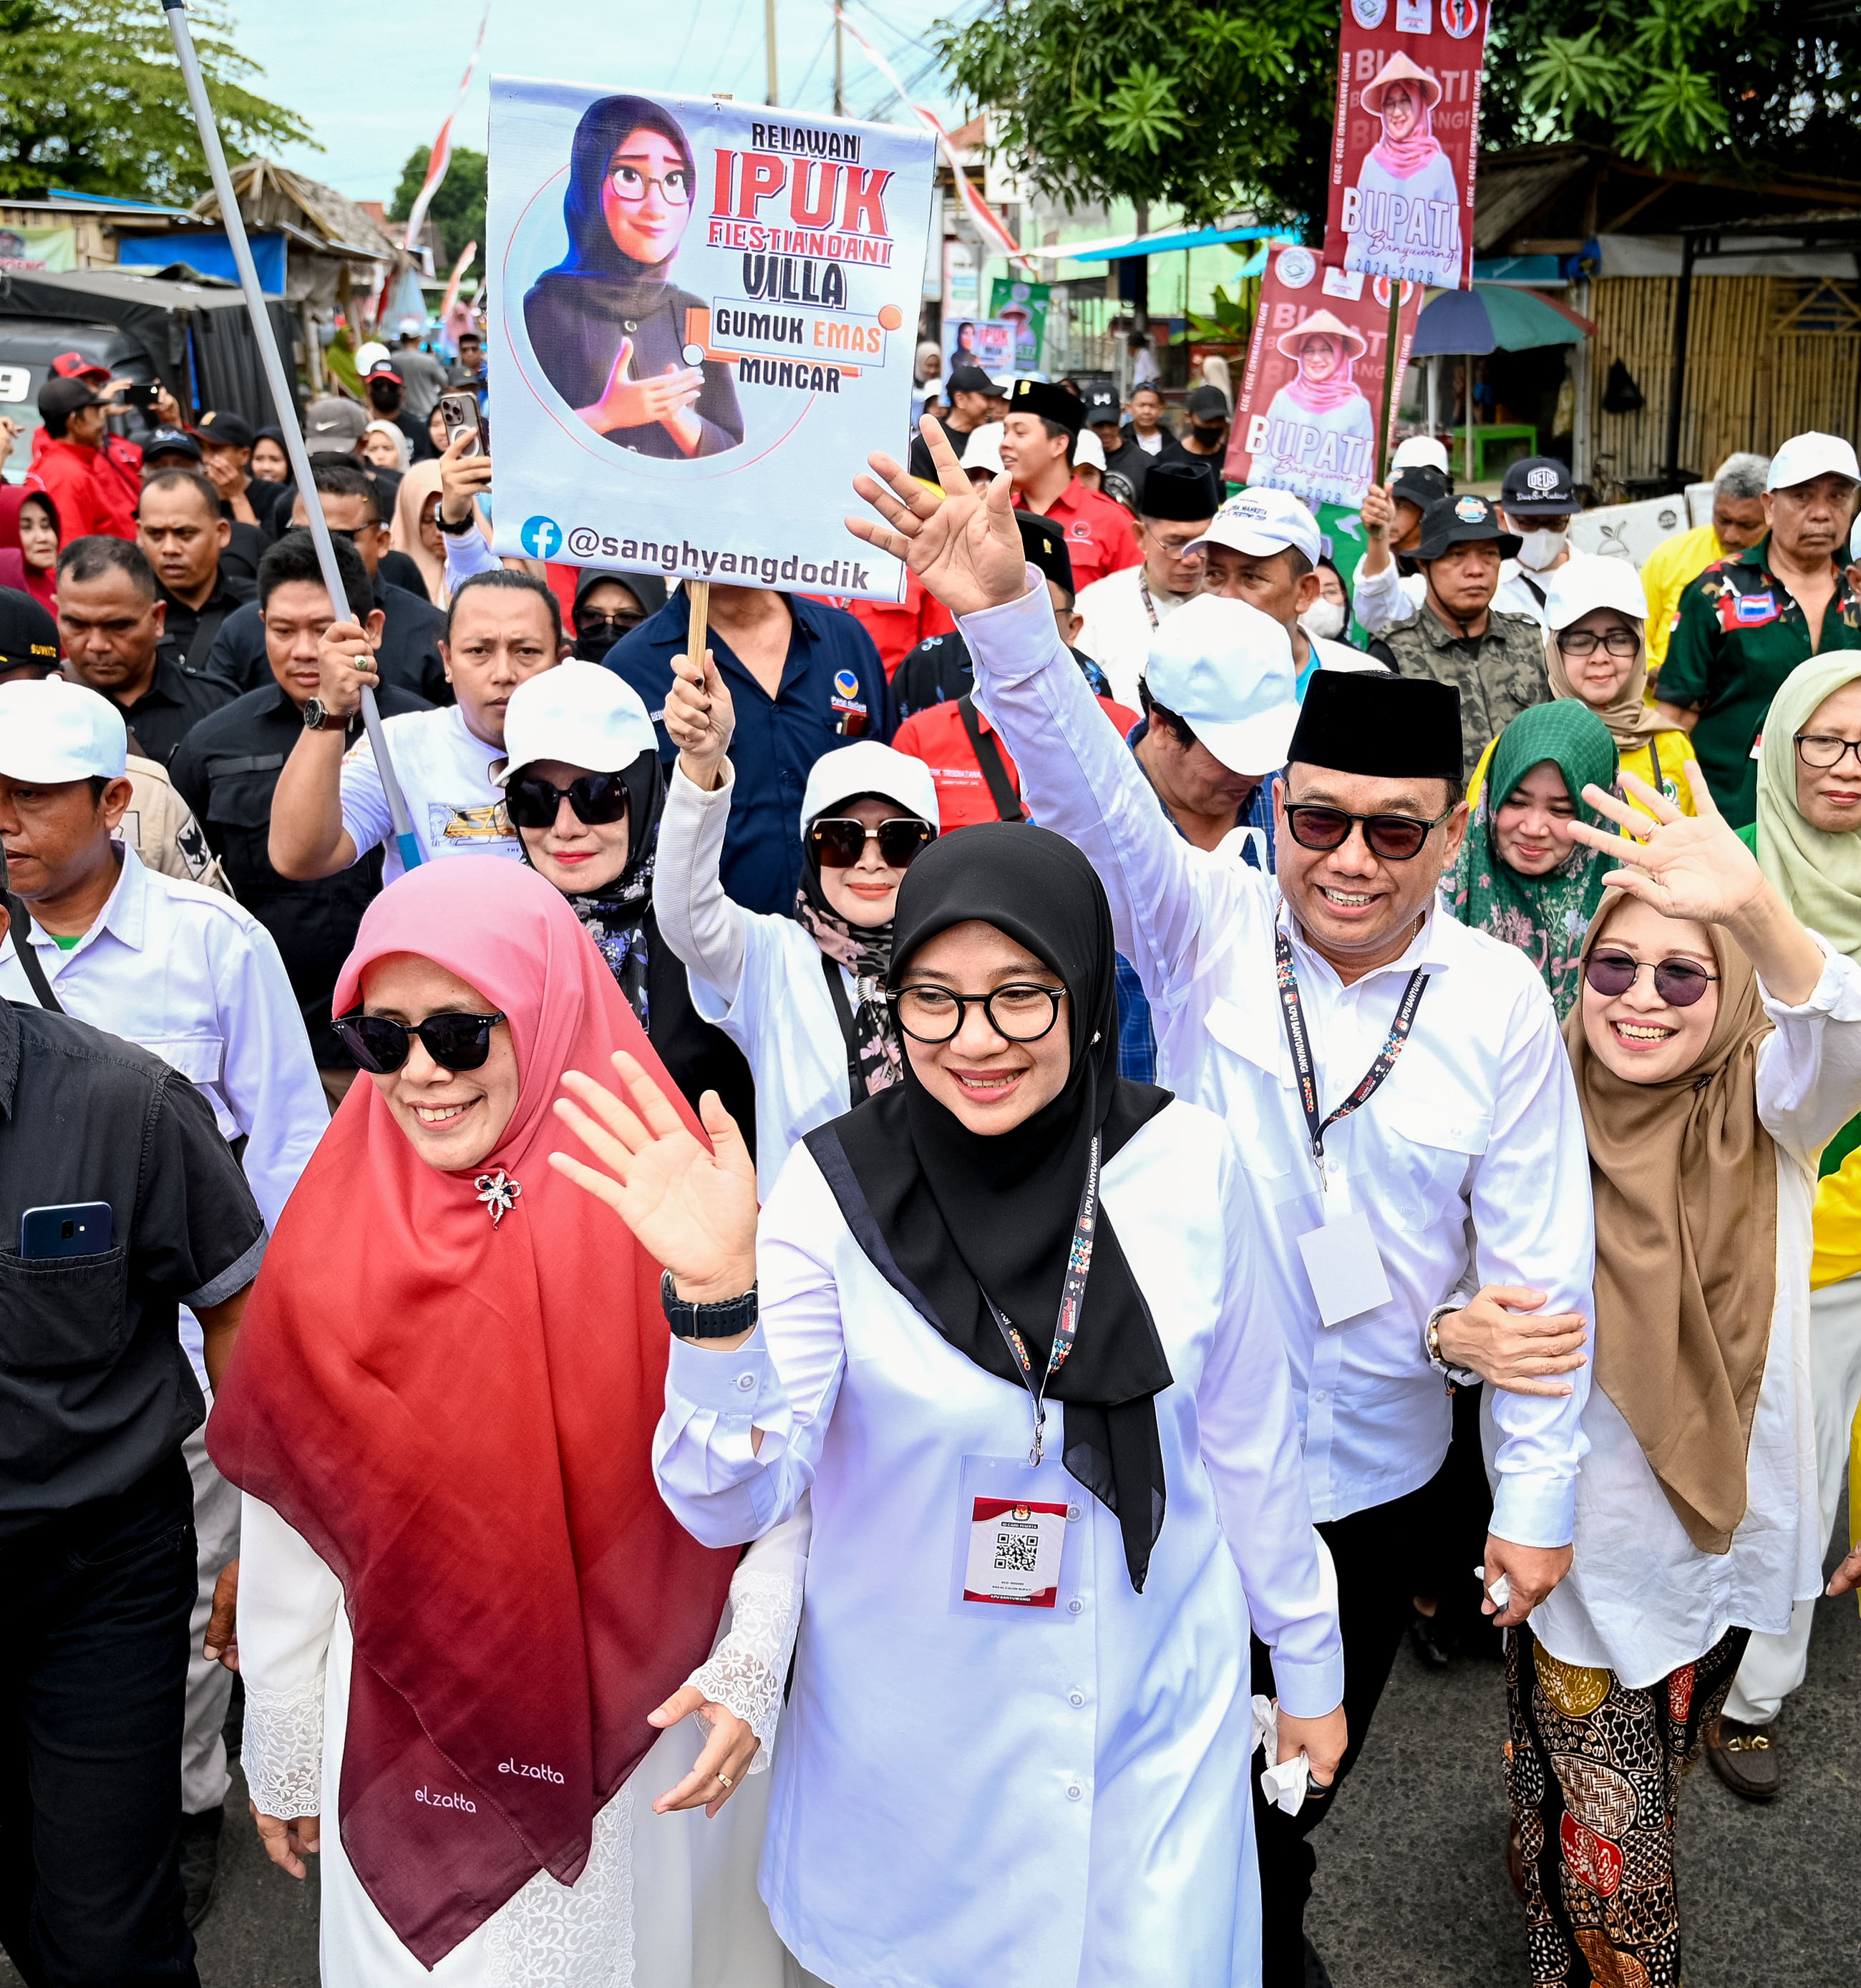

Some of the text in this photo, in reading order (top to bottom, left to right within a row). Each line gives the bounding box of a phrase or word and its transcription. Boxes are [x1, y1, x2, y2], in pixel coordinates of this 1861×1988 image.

[752, 122, 860, 162] RELAWAN
[711, 148, 893, 238] IPUK
[1341, 186, 1460, 251] BUPATI
[707, 221, 892, 266] FIESTIANDANI
[742, 253, 846, 310] VILLA
[1356, 258, 1434, 285] 2024-2029
[716, 308, 882, 354] GUMUK EMAS
[739, 357, 840, 394] MUNCAR
[1245, 414, 1374, 478] BUPATI
[1532, 471, 1555, 487] DEUS
[568, 527, 870, 591] @sanghyangdodik
[1288, 1005, 1299, 1021] KPU
[1401, 970, 1424, 1021] KPU BANYUWAN
[1290, 1021, 1308, 1073] BANYUWANGI
[1084, 1136, 1098, 1216] KPU BANYUWANGI
